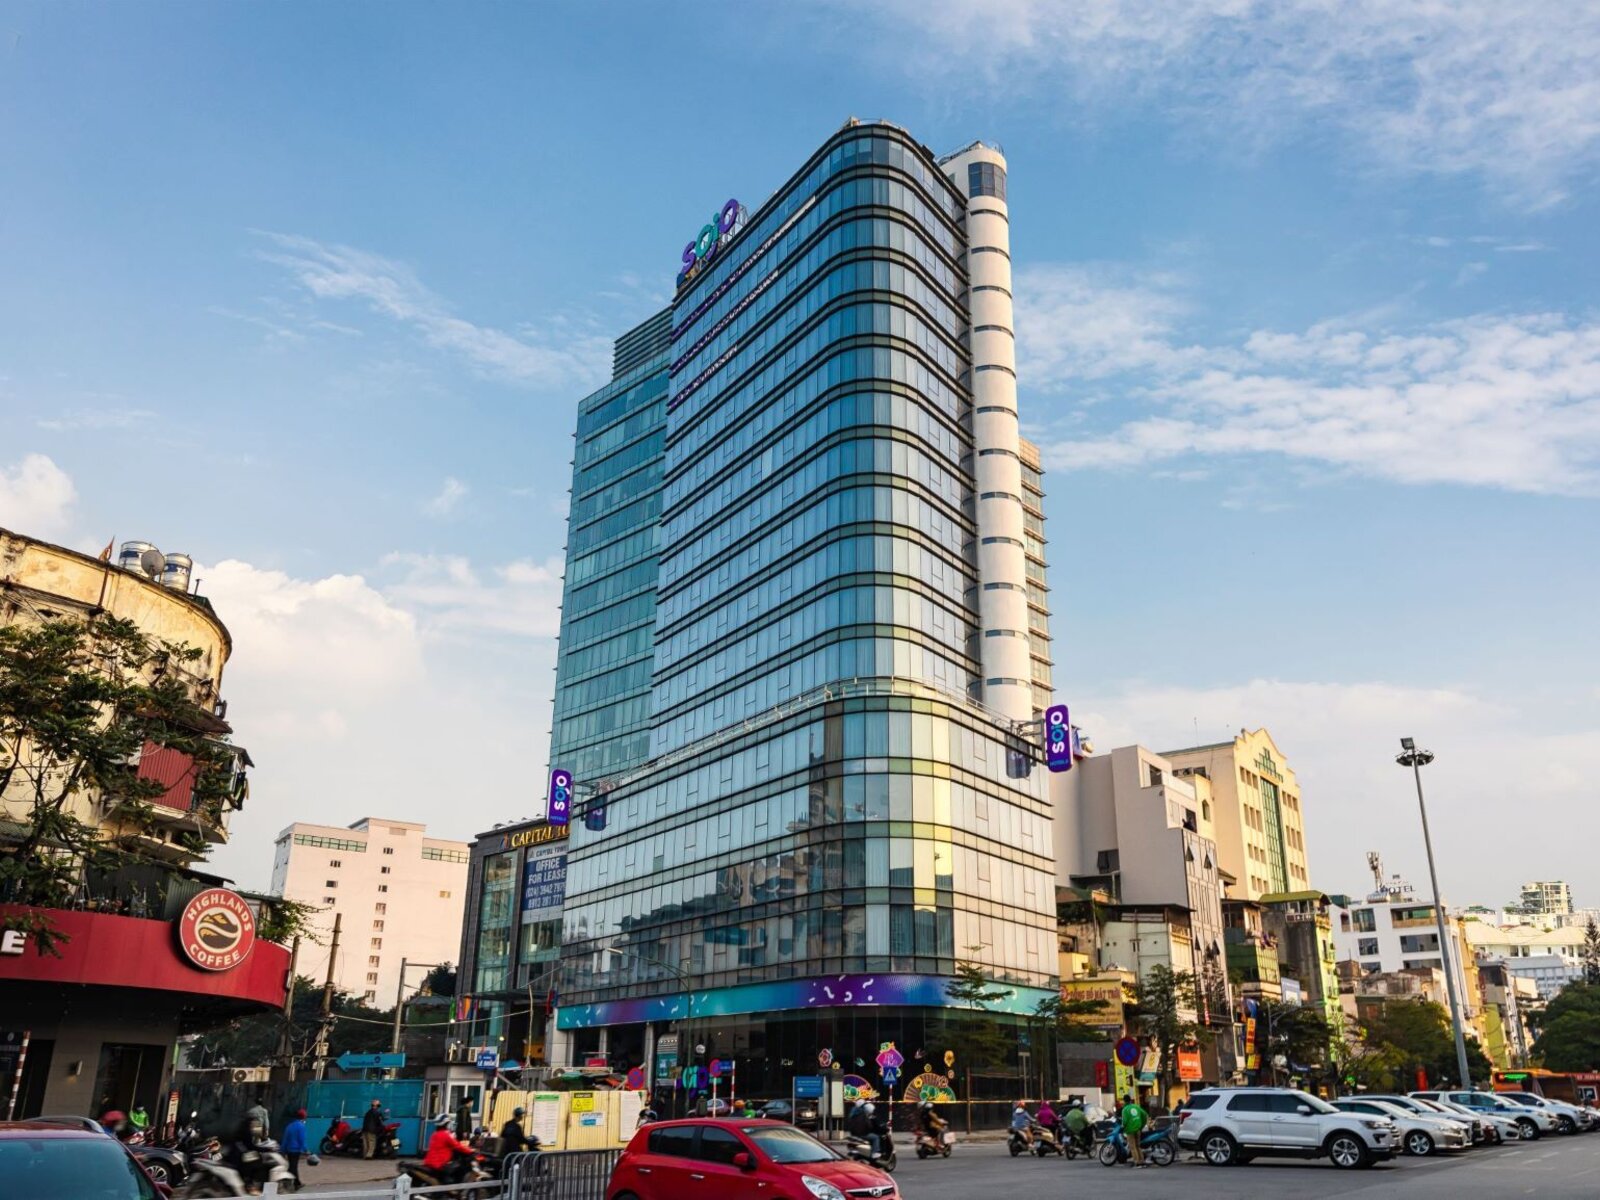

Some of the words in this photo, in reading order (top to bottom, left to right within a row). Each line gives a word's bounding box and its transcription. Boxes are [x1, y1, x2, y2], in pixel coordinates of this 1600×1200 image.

[682, 198, 739, 275] sojo
[1050, 711, 1069, 754] sojo
[554, 775, 570, 811] sojo
[511, 826, 553, 848] CAPITAL
[528, 873, 542, 885] FOR
[543, 868, 566, 882] LEASE
[536, 857, 560, 872] OFFICE
[187, 893, 252, 931] HIGHLANDS
[190, 943, 240, 966] COFFEE
